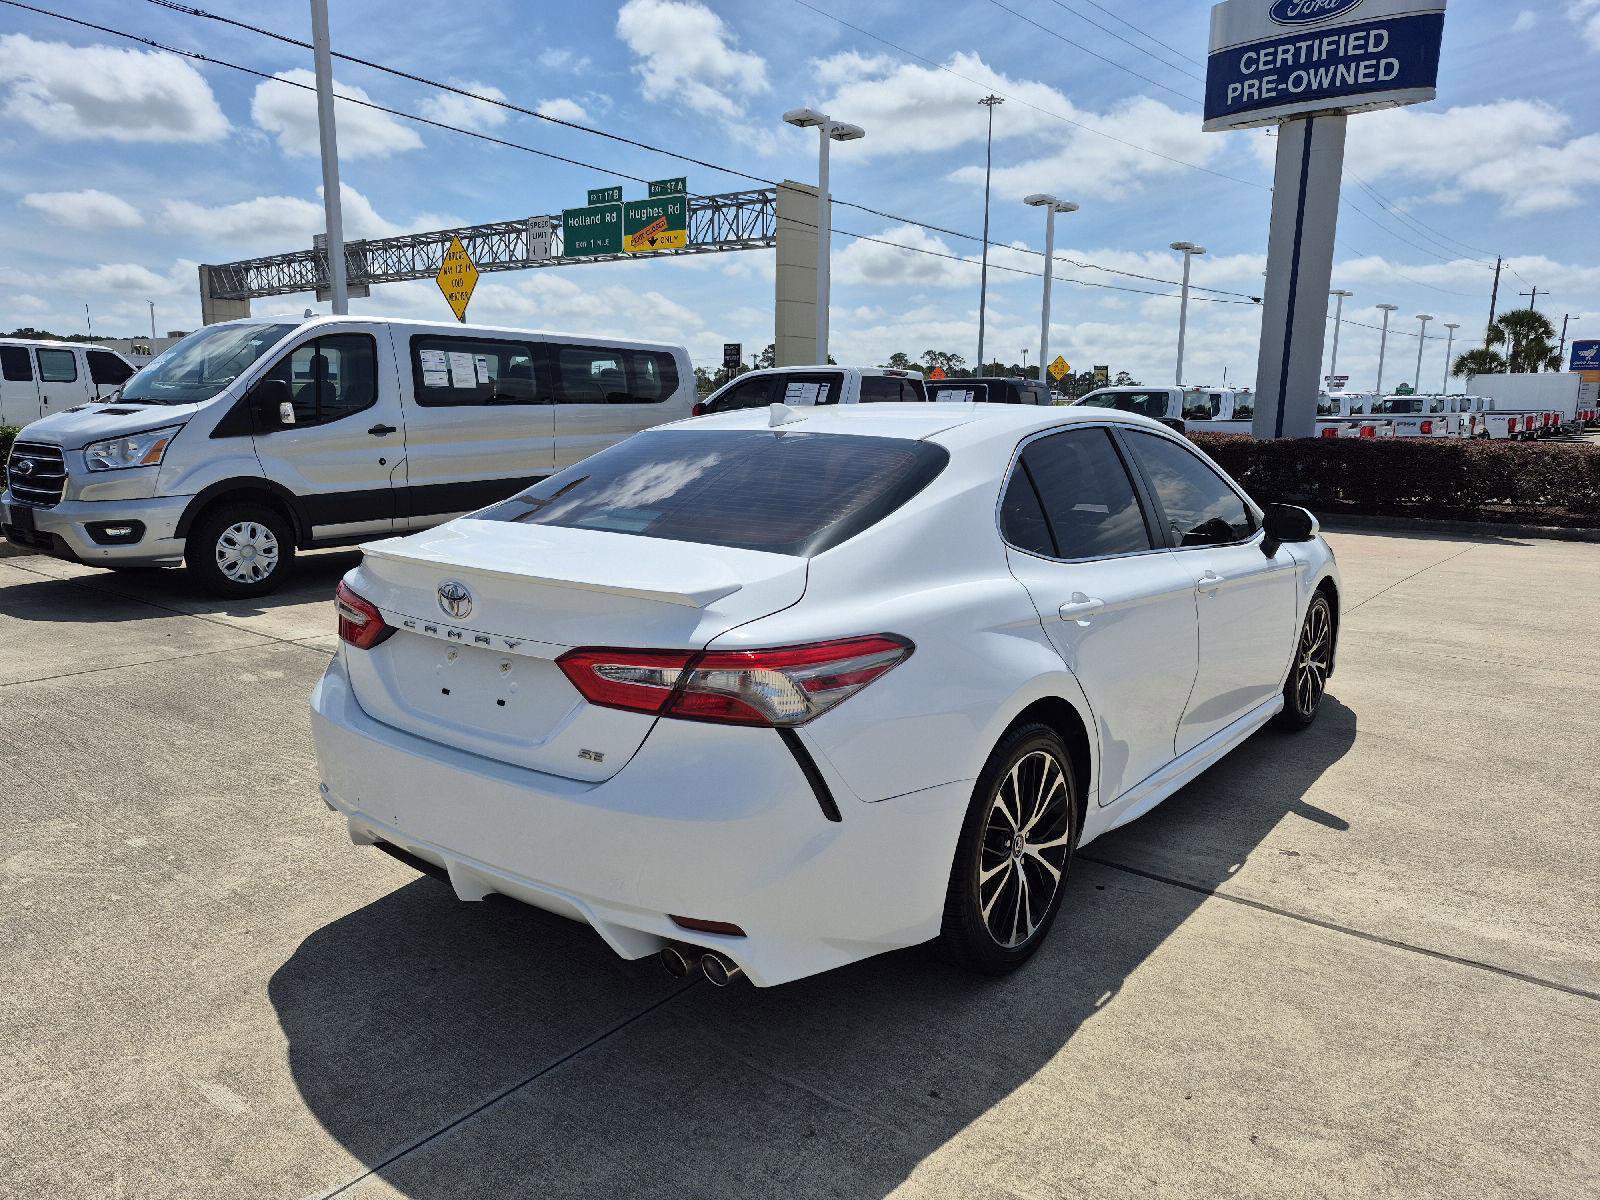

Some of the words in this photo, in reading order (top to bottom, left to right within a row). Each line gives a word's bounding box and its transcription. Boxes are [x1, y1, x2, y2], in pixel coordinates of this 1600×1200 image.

[1239, 28, 1390, 75] CERTIFIED
[1226, 57, 1400, 106] PRE-OWNED
[568, 213, 601, 227] Holland
[605, 211, 617, 223] Rd
[629, 206, 664, 221] Hughes
[668, 202, 680, 215] Rd
[660, 235, 679, 244] ONLY
[403, 619, 522, 650] CAMRY
[577, 748, 605, 763] SE
